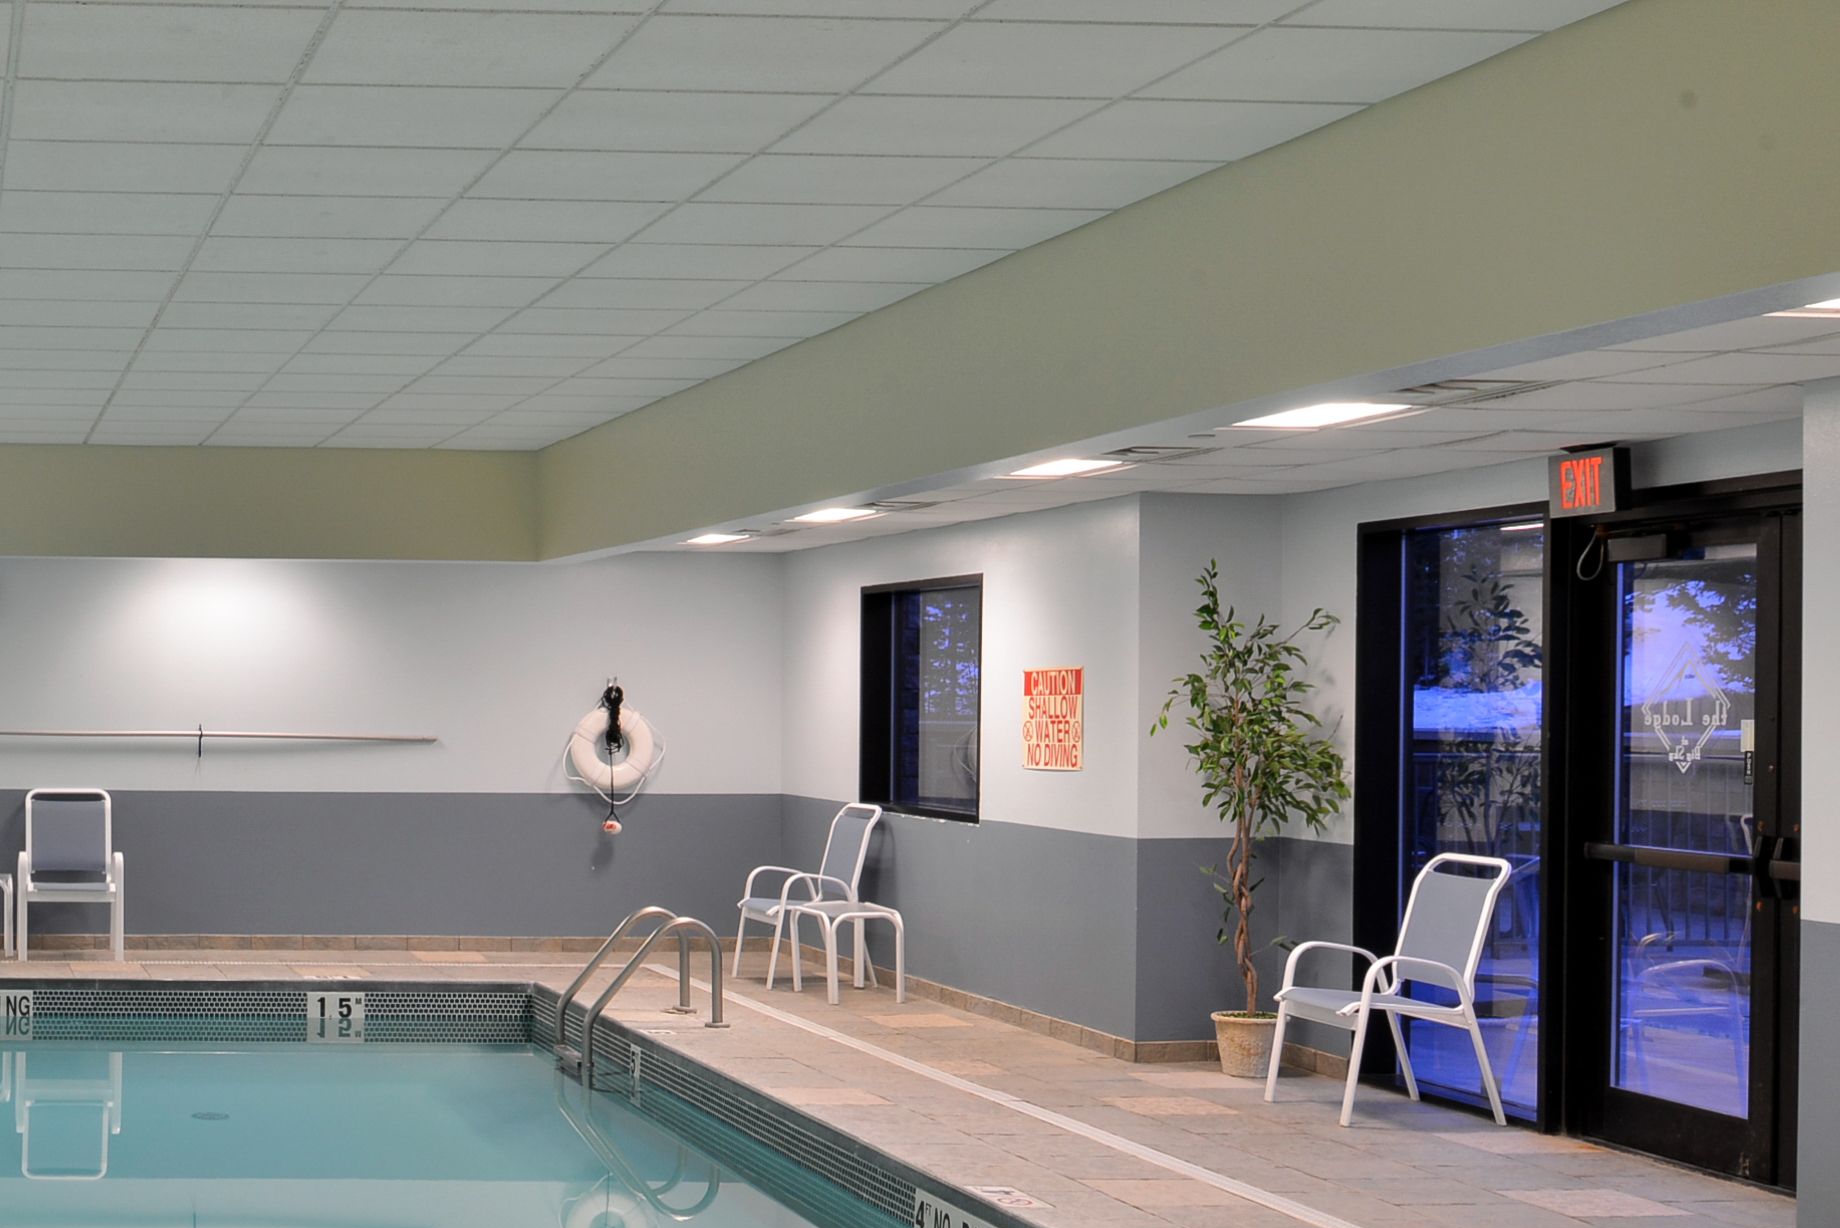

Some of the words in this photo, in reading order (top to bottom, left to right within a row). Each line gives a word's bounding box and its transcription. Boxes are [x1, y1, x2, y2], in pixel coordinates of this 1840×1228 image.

[1561, 456, 1602, 509] EXIT
[1030, 669, 1076, 695] CAUTION
[1028, 695, 1078, 720] SHALLOW
[1035, 720, 1071, 743] WATER
[1027, 743, 1041, 766] NO
[1043, 743, 1078, 768] DIVING
